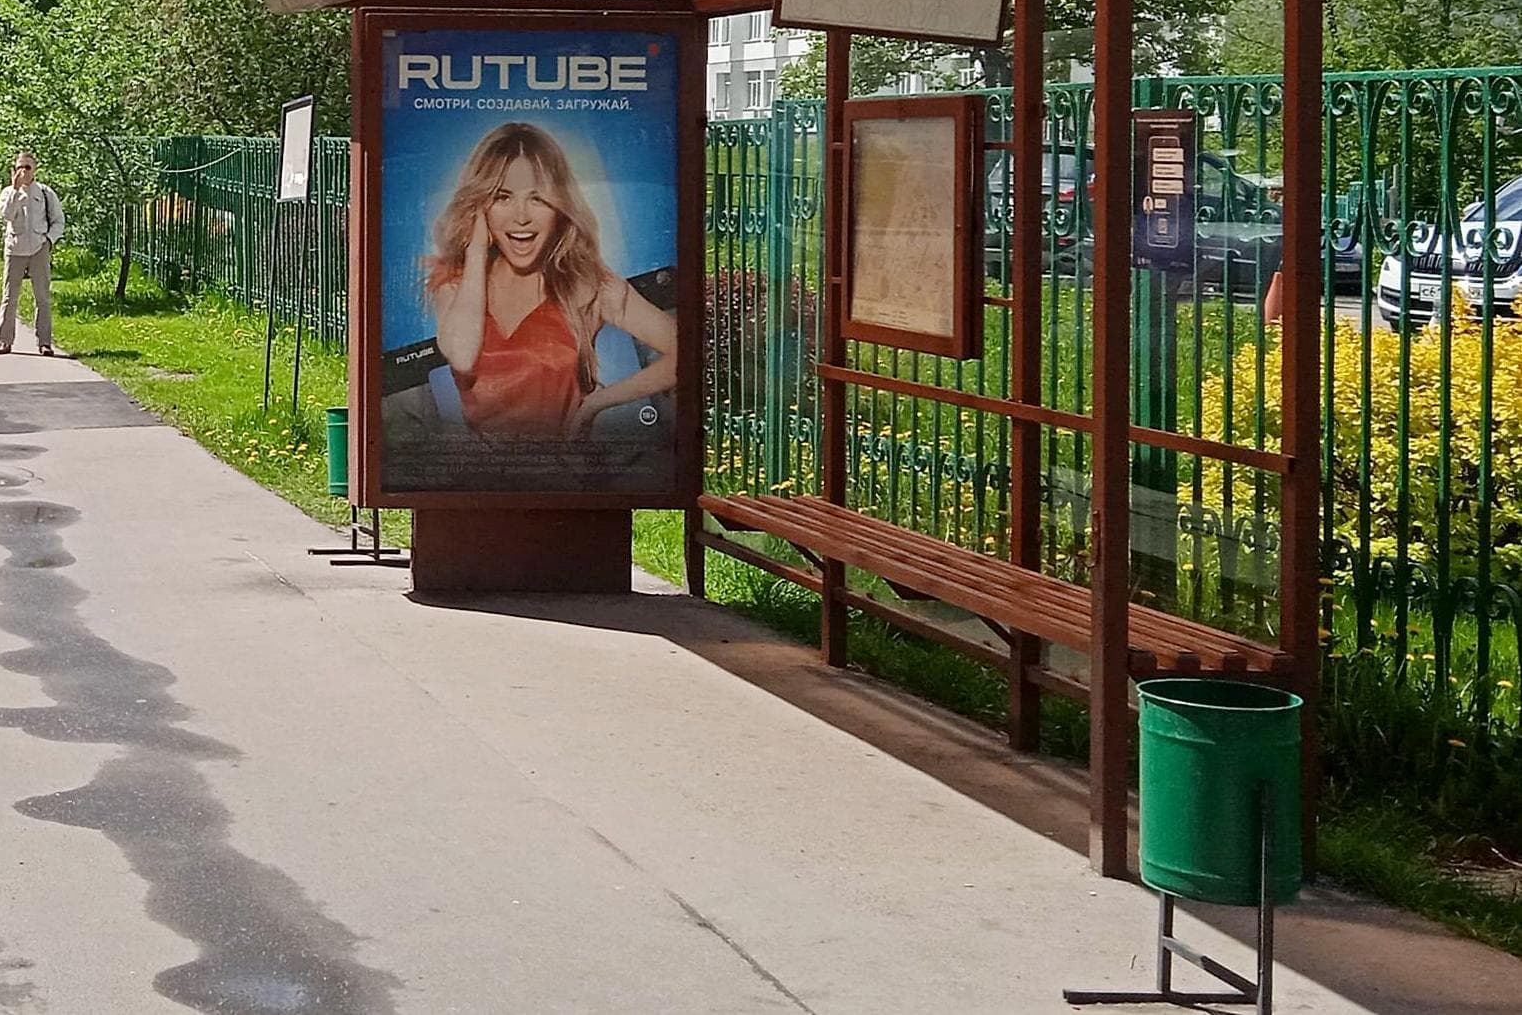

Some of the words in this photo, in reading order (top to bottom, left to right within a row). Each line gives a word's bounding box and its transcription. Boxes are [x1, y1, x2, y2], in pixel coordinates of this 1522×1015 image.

[398, 55, 648, 91] RUTUBE
[414, 98, 474, 110] СМОТРИ.
[477, 97, 554, 111] СОЗДАВАЙ.
[557, 97, 633, 111] ЗАГРУЖАЙ.
